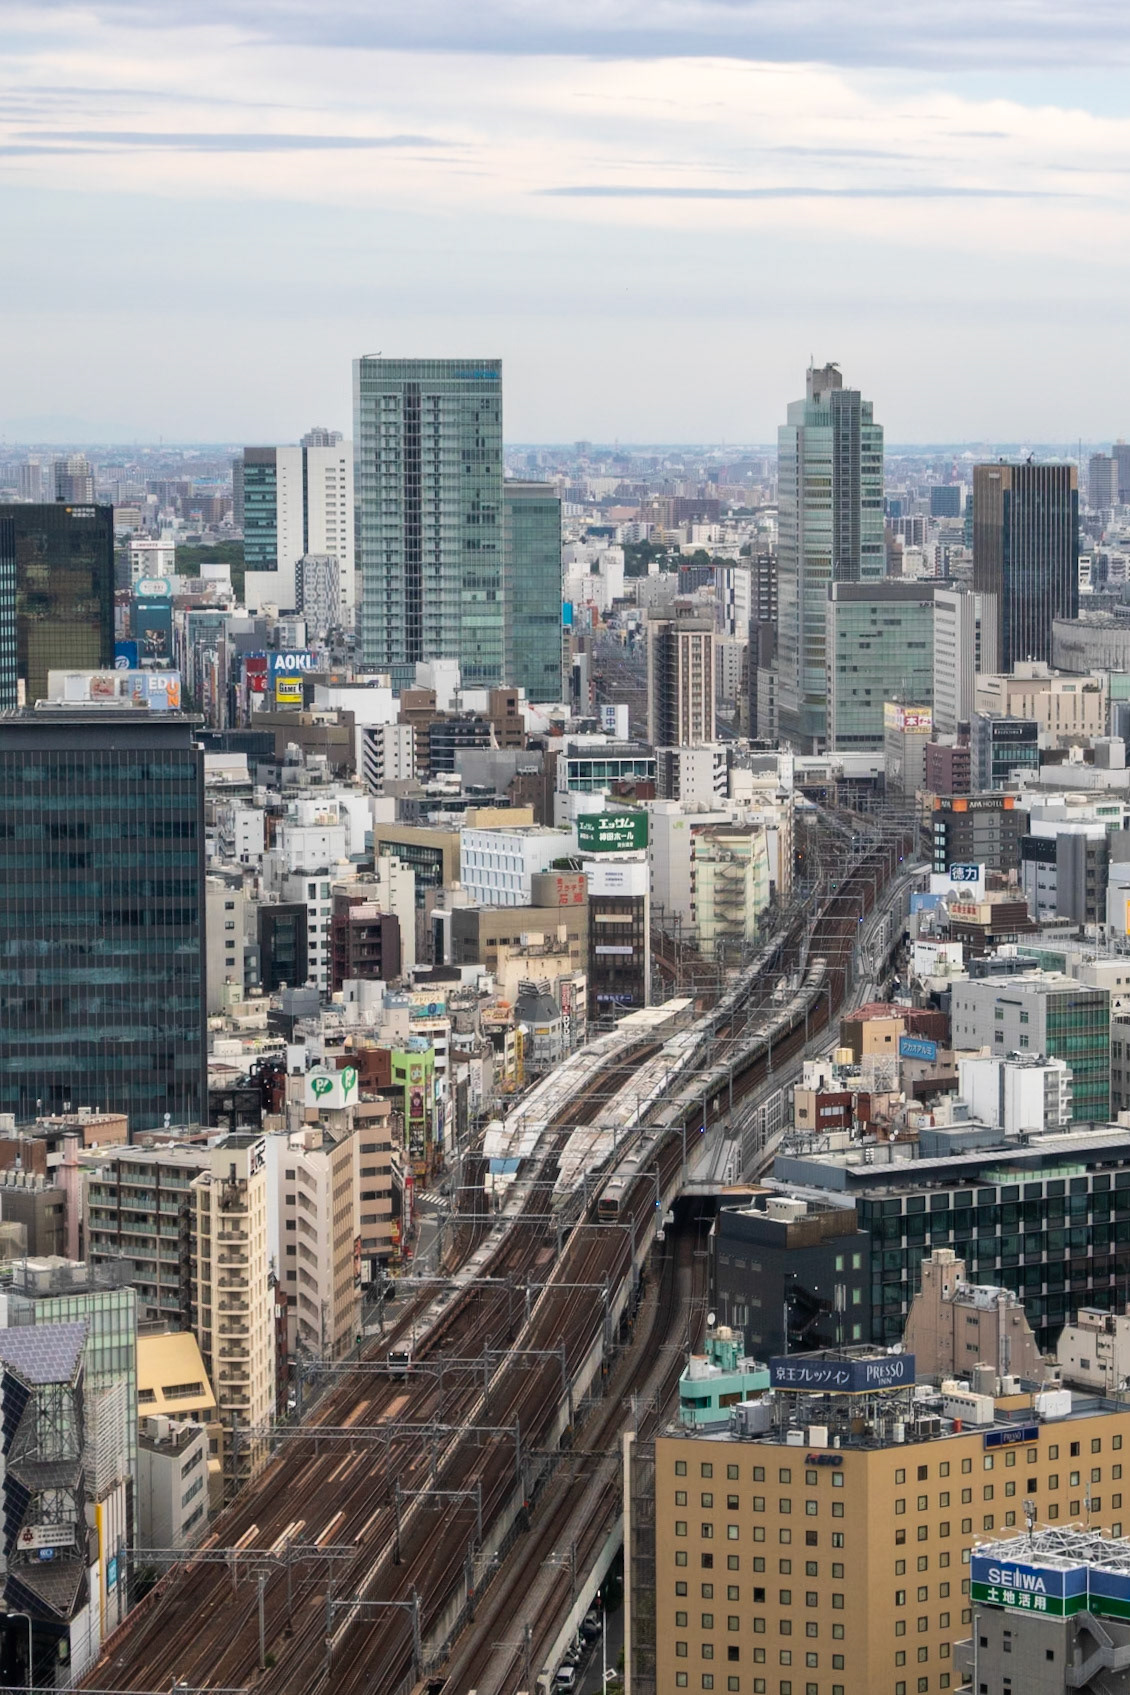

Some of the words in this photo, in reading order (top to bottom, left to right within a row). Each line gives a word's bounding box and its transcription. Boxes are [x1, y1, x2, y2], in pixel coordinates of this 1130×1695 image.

[274, 654, 311, 670] AOKI
[982, 800, 1003, 808] HOTEL
[951, 866, 978, 881] 徳力
[866, 1361, 904, 1382] PRESSO
[804, 1453, 844, 1467] KEIO
[988, 1567, 1047, 1593] SEIWA
[987, 1587, 1047, 1611] 土地活用
